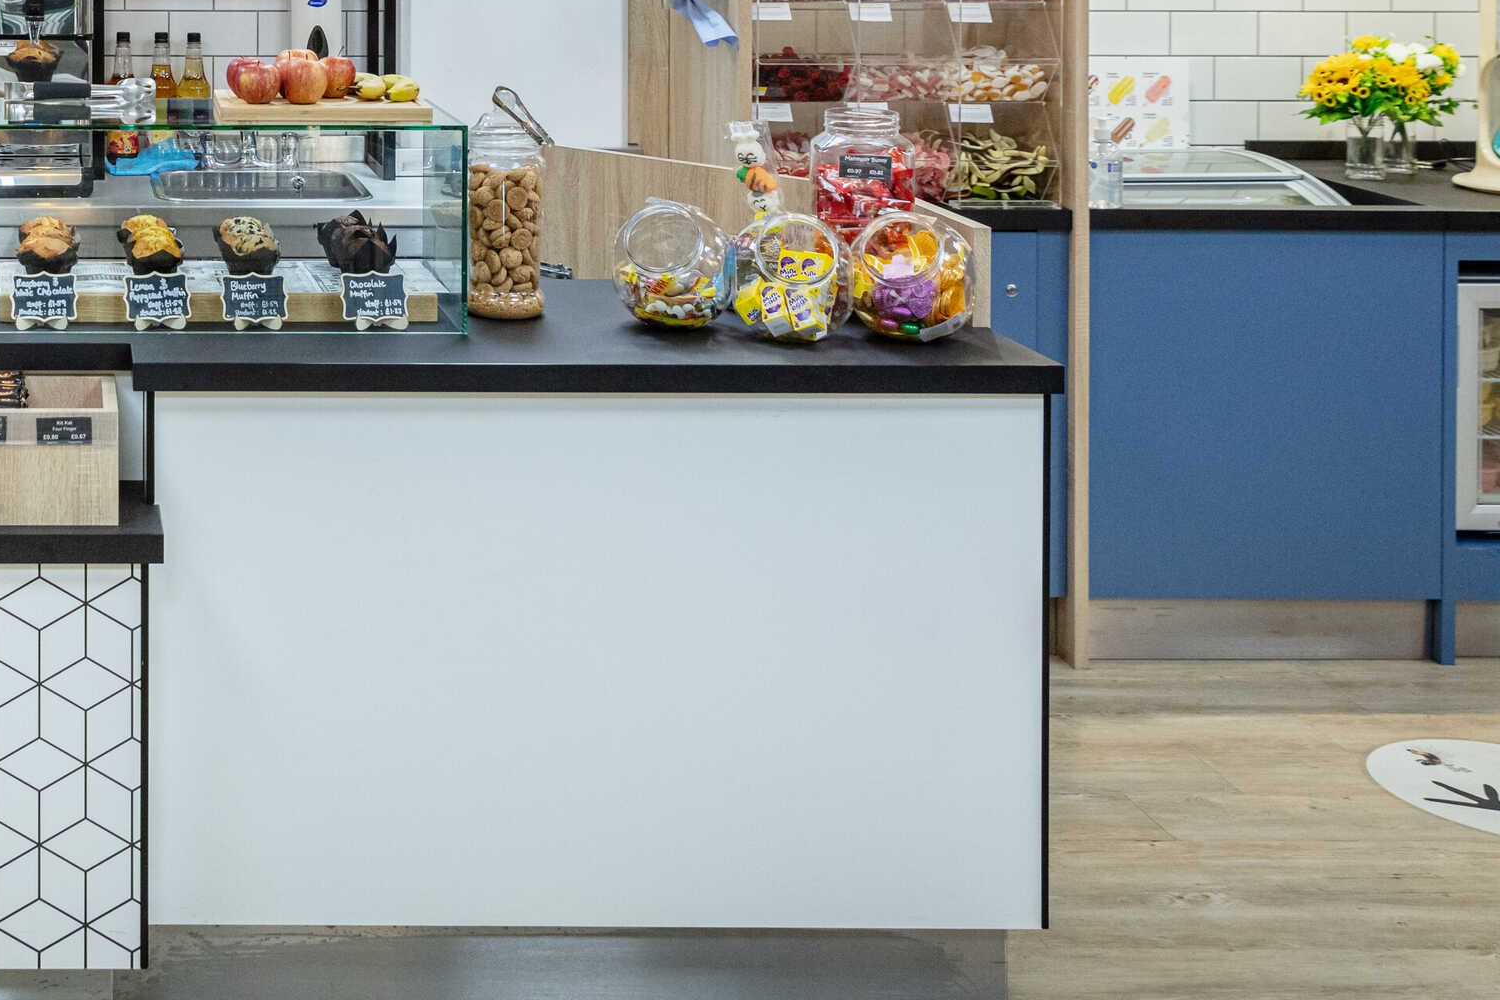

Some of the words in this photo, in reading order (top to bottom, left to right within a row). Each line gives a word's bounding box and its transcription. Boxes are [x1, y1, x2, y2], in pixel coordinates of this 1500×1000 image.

[129, 279, 155, 292] Lemon
[230, 280, 267, 293] Blueberry
[349, 279, 388, 289] Chocolate
[231, 291, 259, 301] Muffin
[349, 289, 374, 299] Muffin
